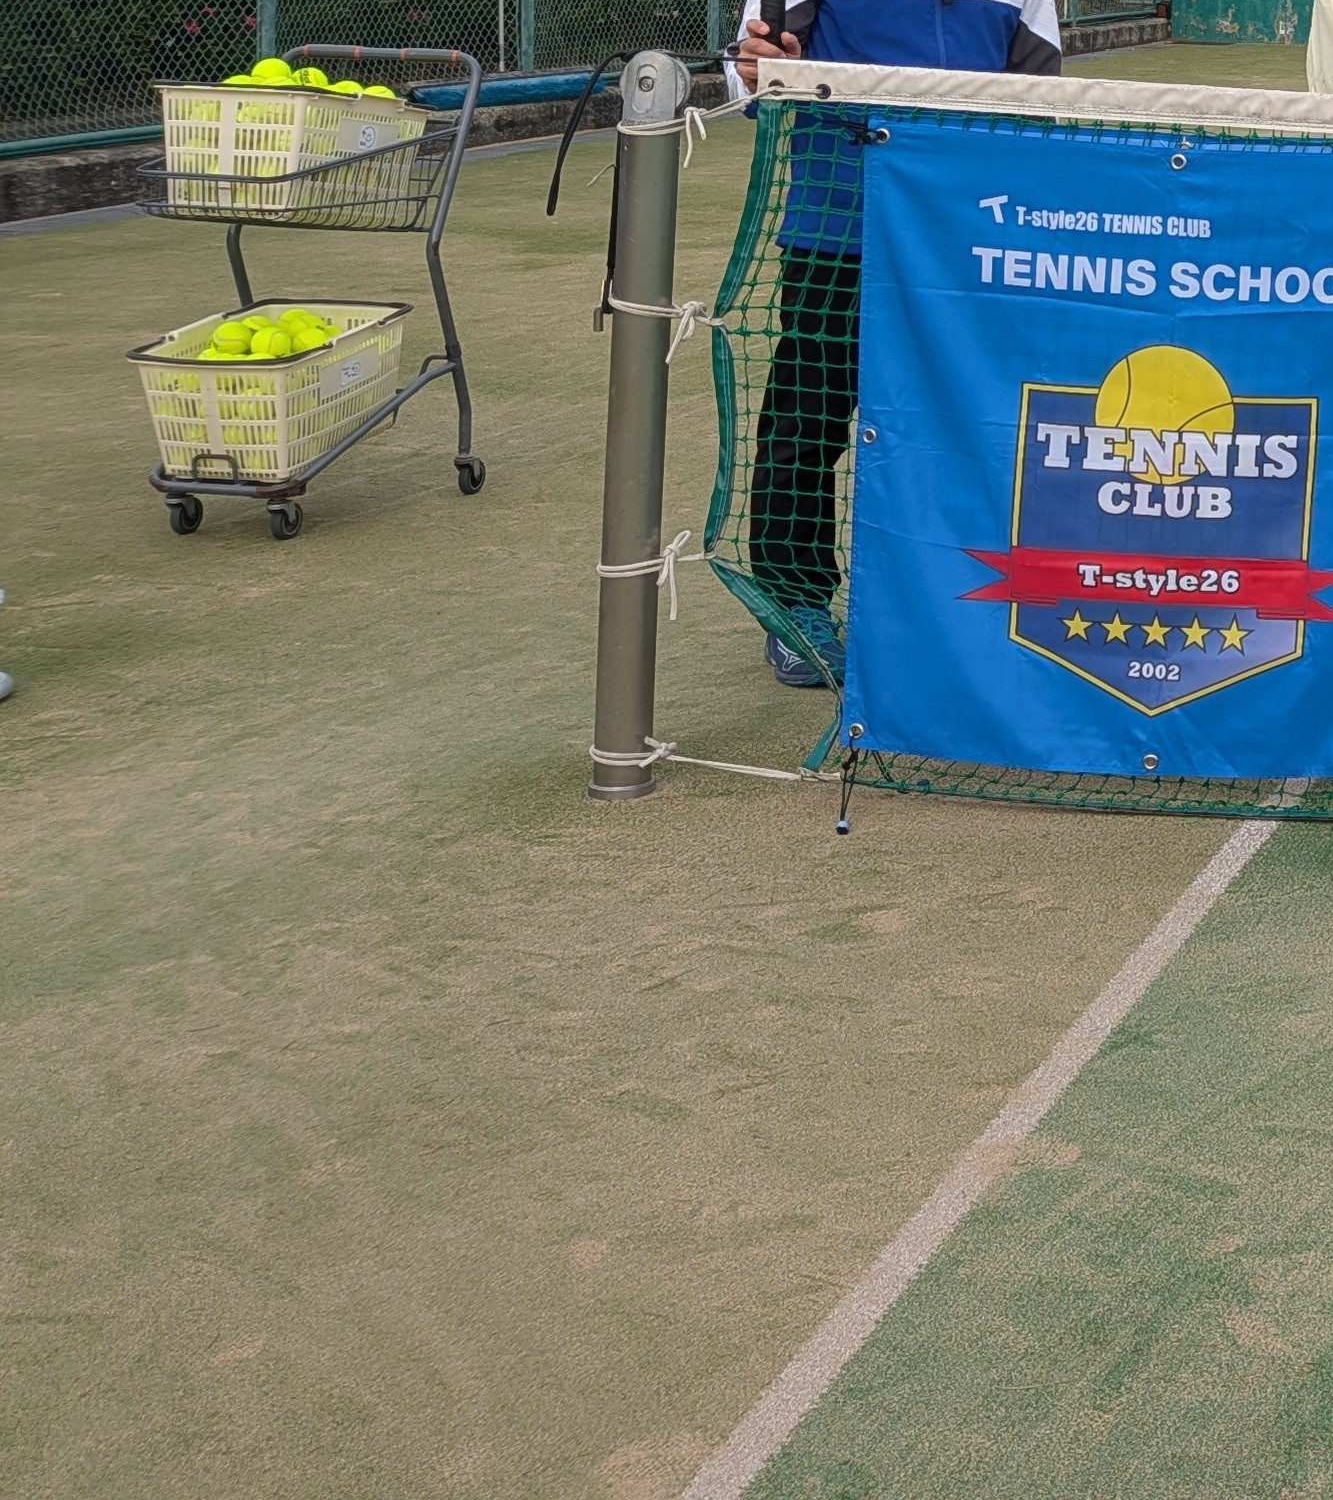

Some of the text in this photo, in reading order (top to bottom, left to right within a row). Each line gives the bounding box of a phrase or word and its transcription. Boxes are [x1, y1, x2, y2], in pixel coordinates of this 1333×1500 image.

[1016, 206, 1098, 232] T-style26
[1102, 213, 1163, 236] TENNIS
[1167, 216, 1211, 238] CLUB
[972, 246, 1157, 297] TENNIS
[1036, 422, 1299, 479] TENNIS
[1097, 481, 1233, 519] CLUB
[1078, 564, 1240, 596] T-style26
[1128, 661, 1180, 680] 2002
